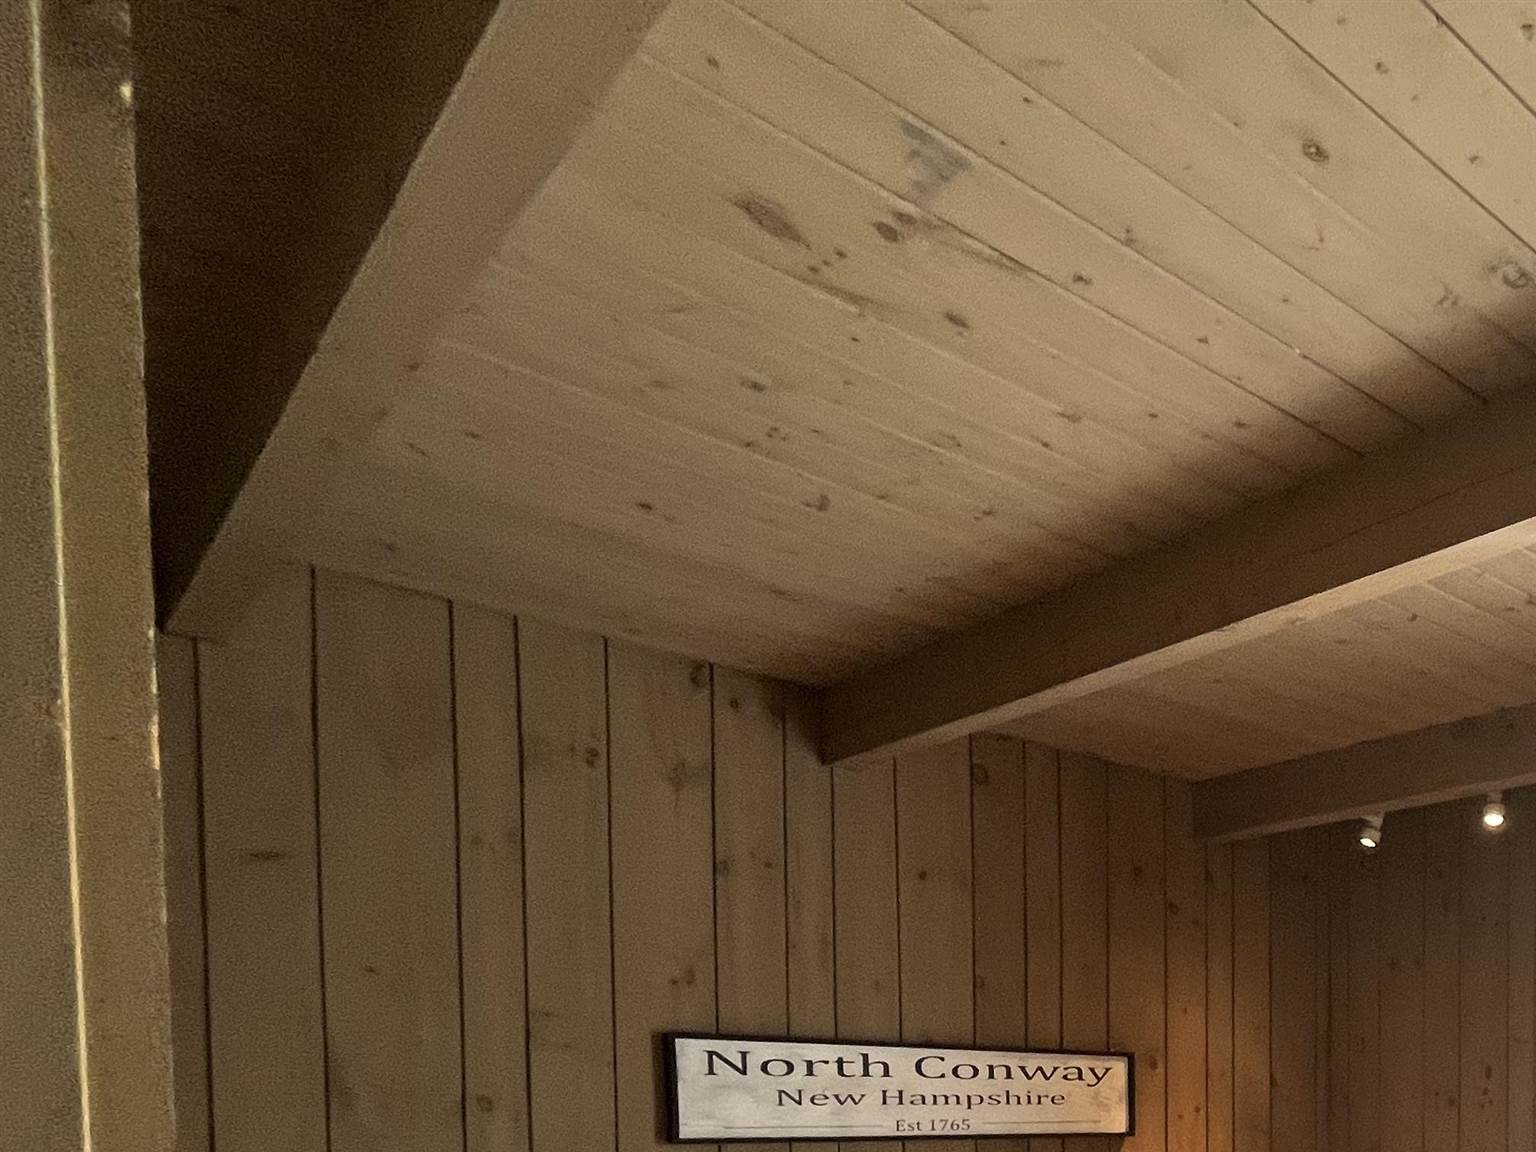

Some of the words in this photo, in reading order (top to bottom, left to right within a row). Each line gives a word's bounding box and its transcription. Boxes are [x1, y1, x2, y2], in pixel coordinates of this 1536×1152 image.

[703, 1049, 892, 1079] North
[914, 1053, 1114, 1087] Conway
[776, 1088, 867, 1107] New
[880, 1089, 1066, 1110] Hampshire
[895, 1118, 922, 1132] Est
[929, 1118, 971, 1132] 1765
